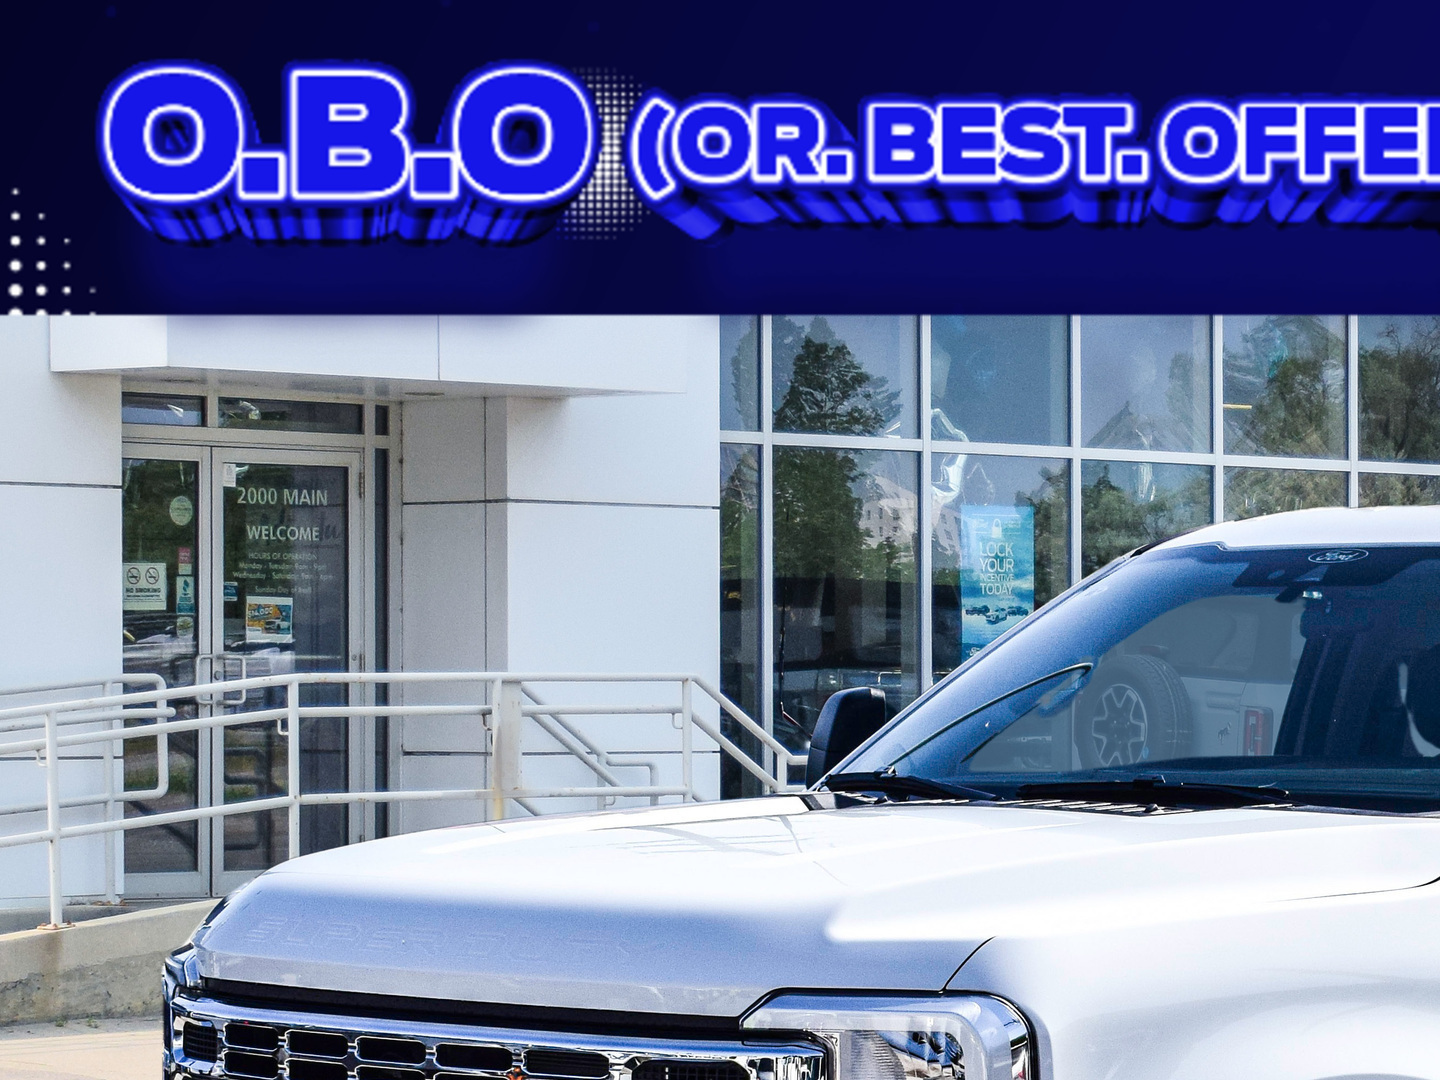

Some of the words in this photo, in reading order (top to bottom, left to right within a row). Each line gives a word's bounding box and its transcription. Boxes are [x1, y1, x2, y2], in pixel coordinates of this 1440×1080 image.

[237, 487, 278, 504] 2000
[283, 488, 328, 507] MAIN
[246, 525, 320, 542] WELCOME
[248, 552, 271, 560] HOURS
[271, 552, 281, 560] OF
[282, 552, 318, 561] OPERATION
[979, 541, 1014, 557] LOCK
[979, 558, 1015, 573] YOUR
[979, 573, 1015, 582] INCENTIVE
[979, 583, 1014, 595] TODAY
